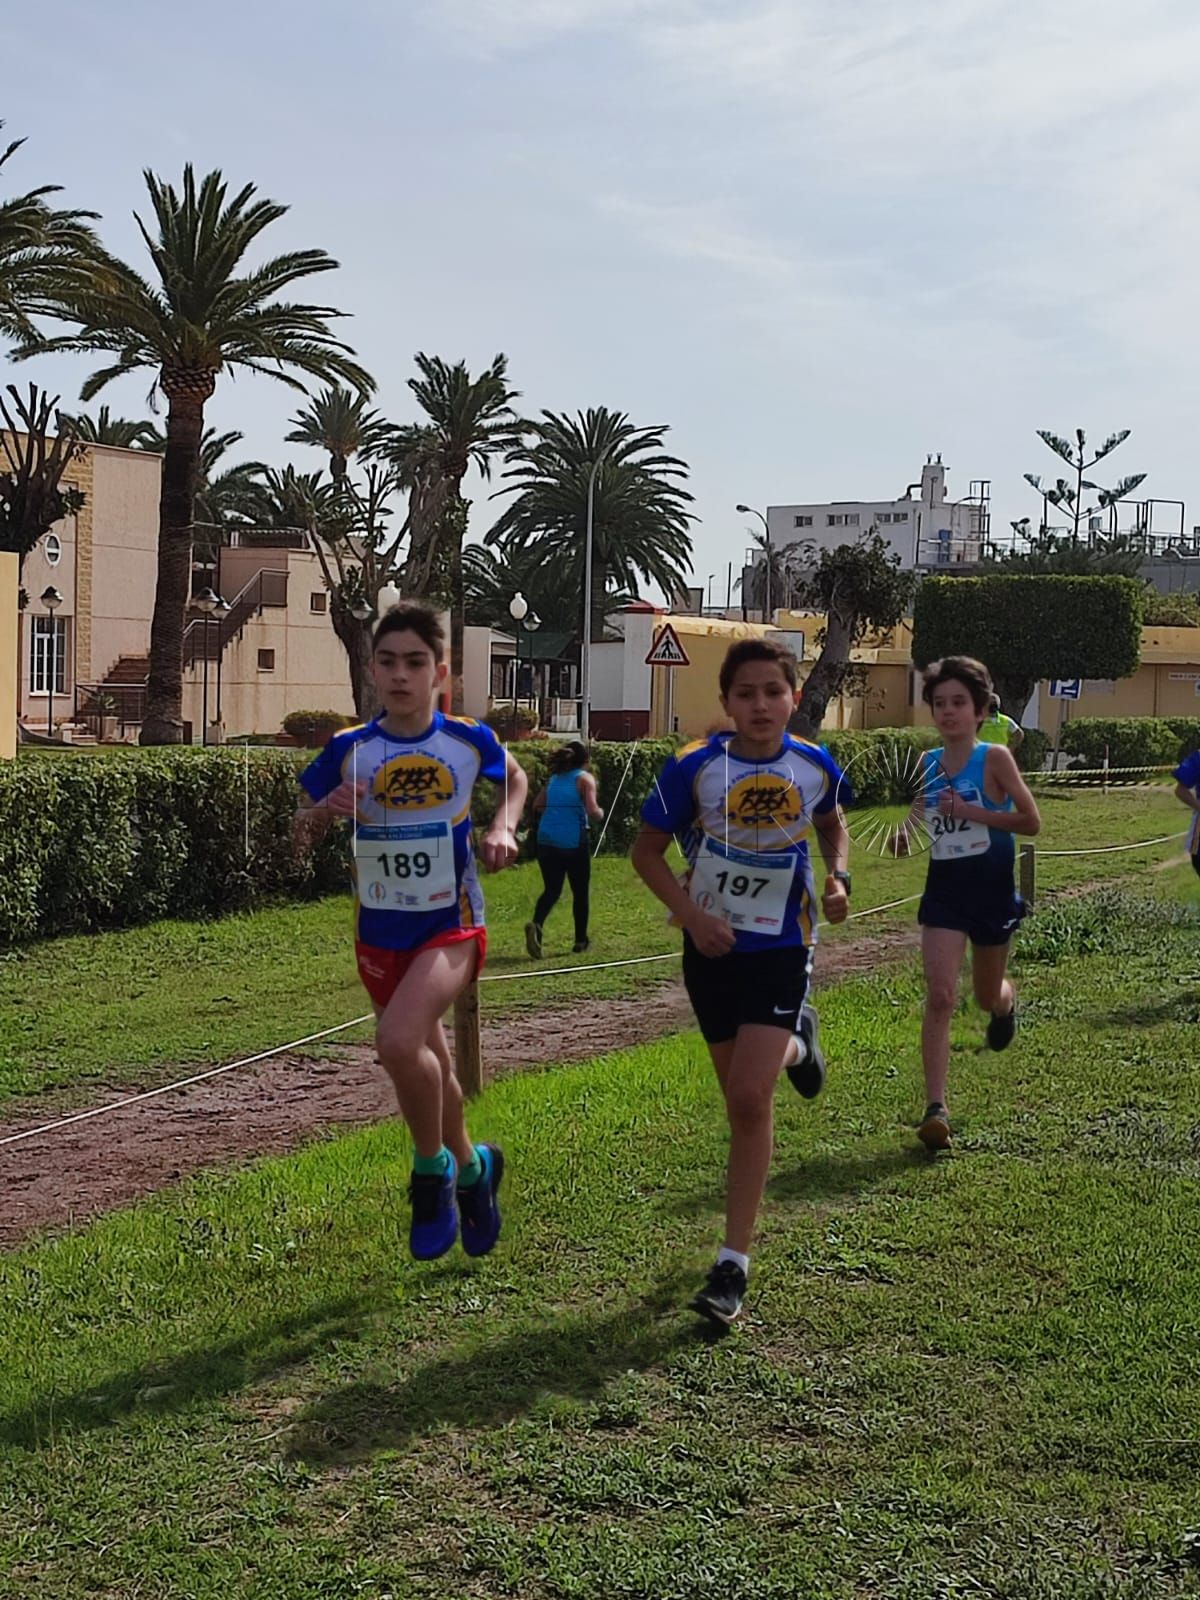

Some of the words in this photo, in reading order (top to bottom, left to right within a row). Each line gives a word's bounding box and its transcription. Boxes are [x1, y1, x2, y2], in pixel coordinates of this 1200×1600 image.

[931, 815, 972, 836] 202
[376, 851, 432, 879] 189
[715, 870, 771, 898] 197
